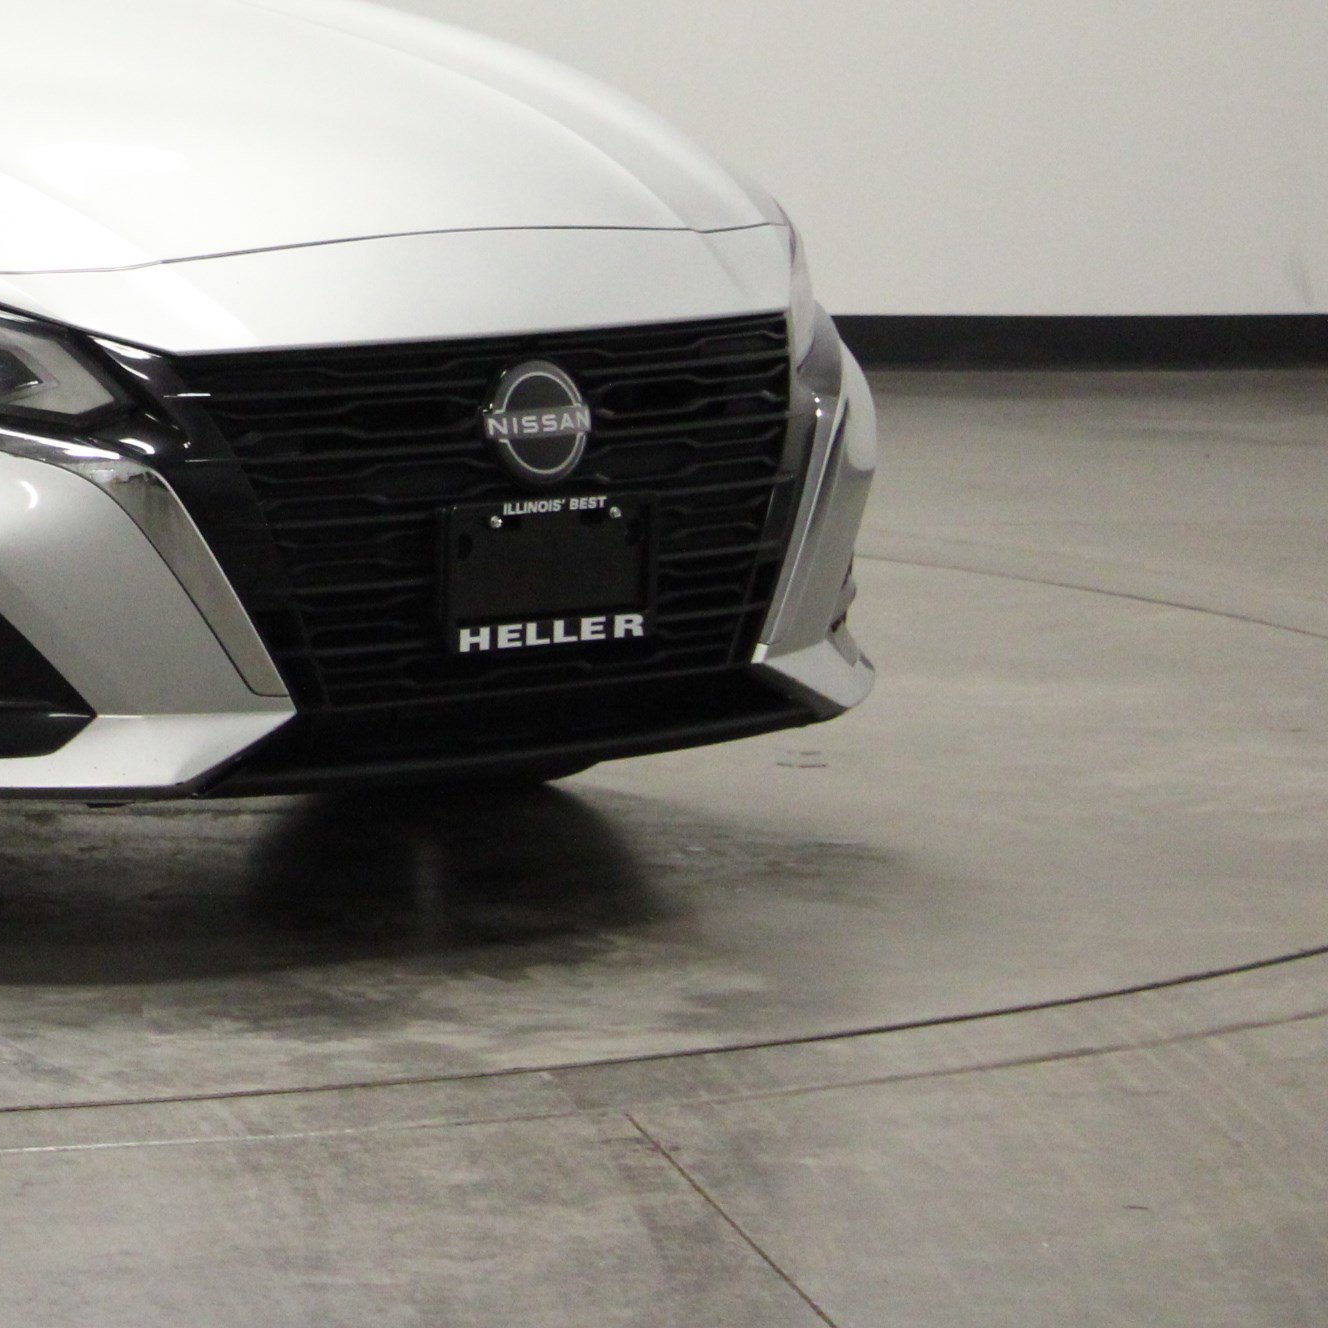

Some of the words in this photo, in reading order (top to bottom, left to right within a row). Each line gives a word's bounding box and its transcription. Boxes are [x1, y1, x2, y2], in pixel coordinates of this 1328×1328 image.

[487, 409, 592, 437] NISSAN
[569, 495, 608, 511] BEST
[459, 613, 644, 653] HELLER
